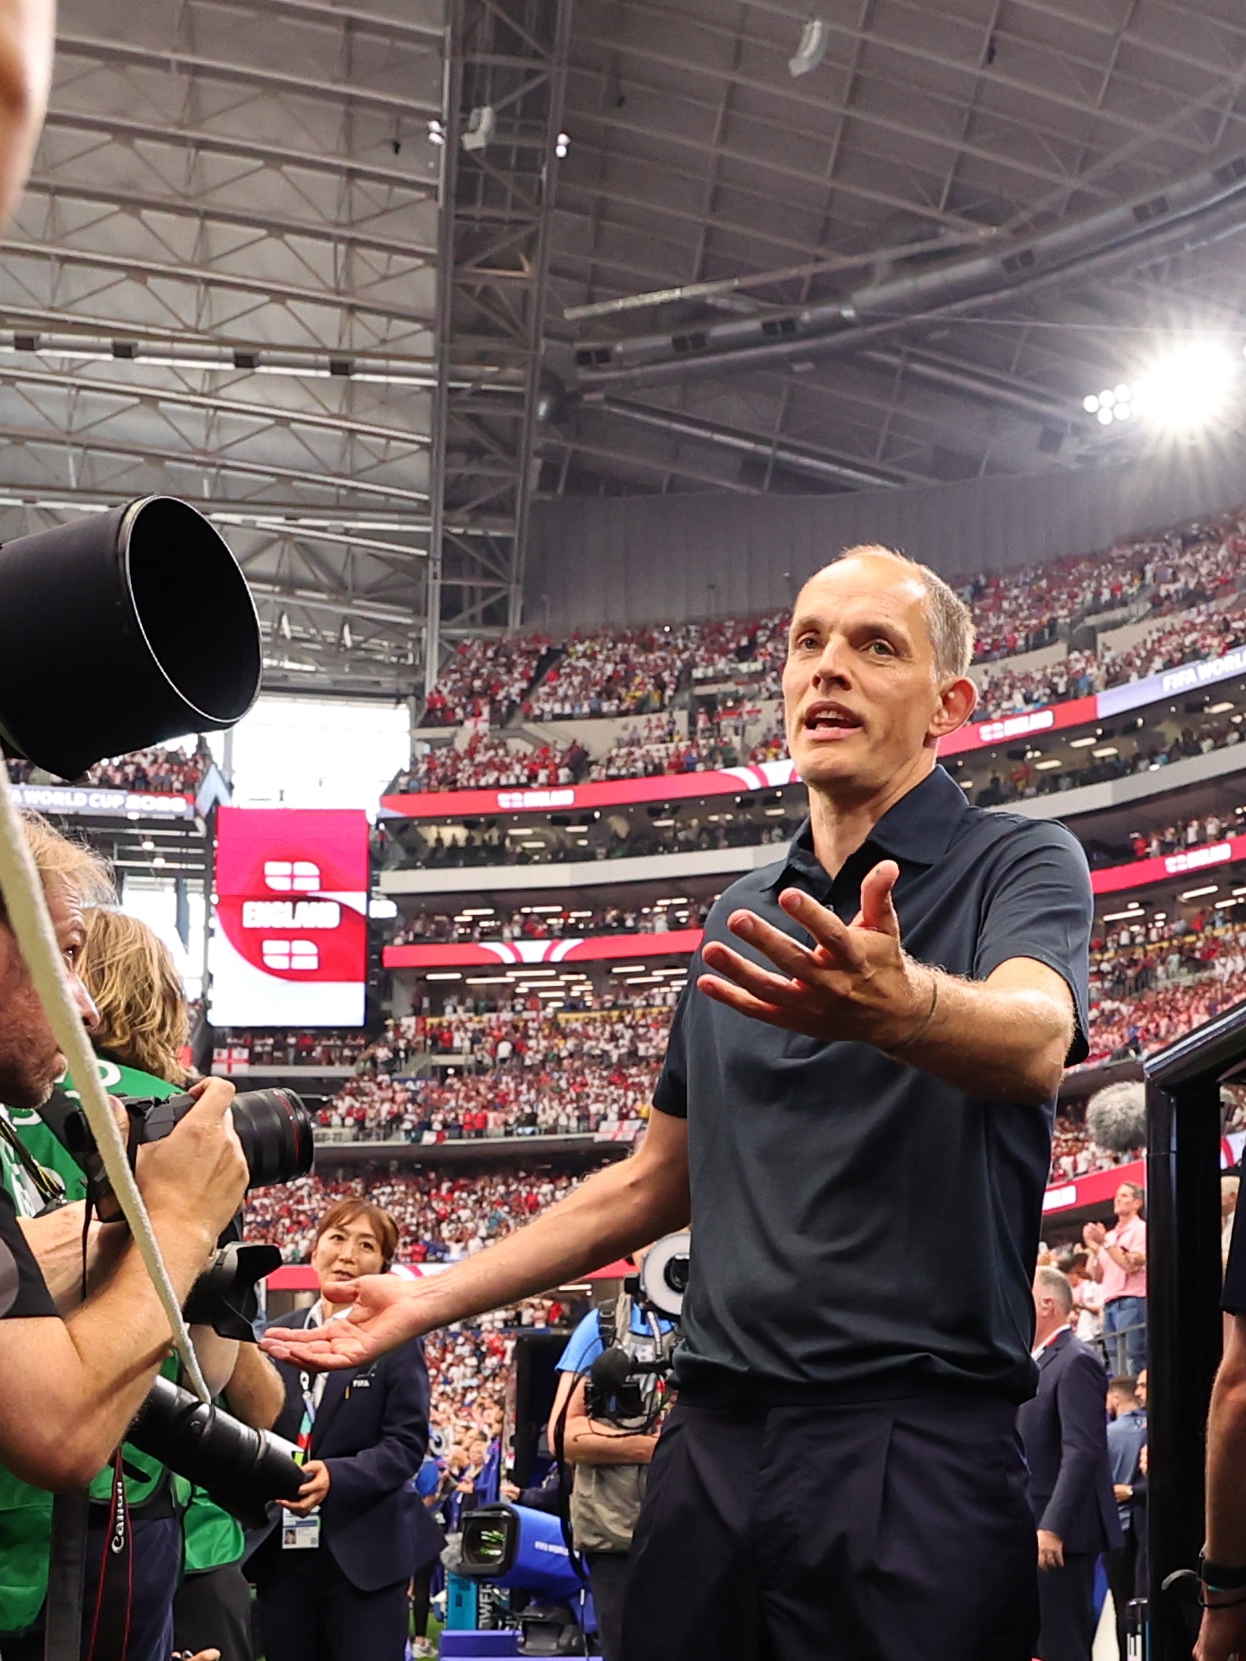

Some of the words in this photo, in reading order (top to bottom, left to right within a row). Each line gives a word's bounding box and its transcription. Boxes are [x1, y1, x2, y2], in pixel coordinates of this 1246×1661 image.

[1162, 667, 1197, 692] FIFA
[23, 789, 87, 807] WORLD
[88, 792, 124, 809] CUP
[125, 794, 187, 812] 2026
[242, 901, 341, 928] ENGLAND
[352, 1379, 370, 1388] FIFA
[111, 1481, 125, 1554] Canon
